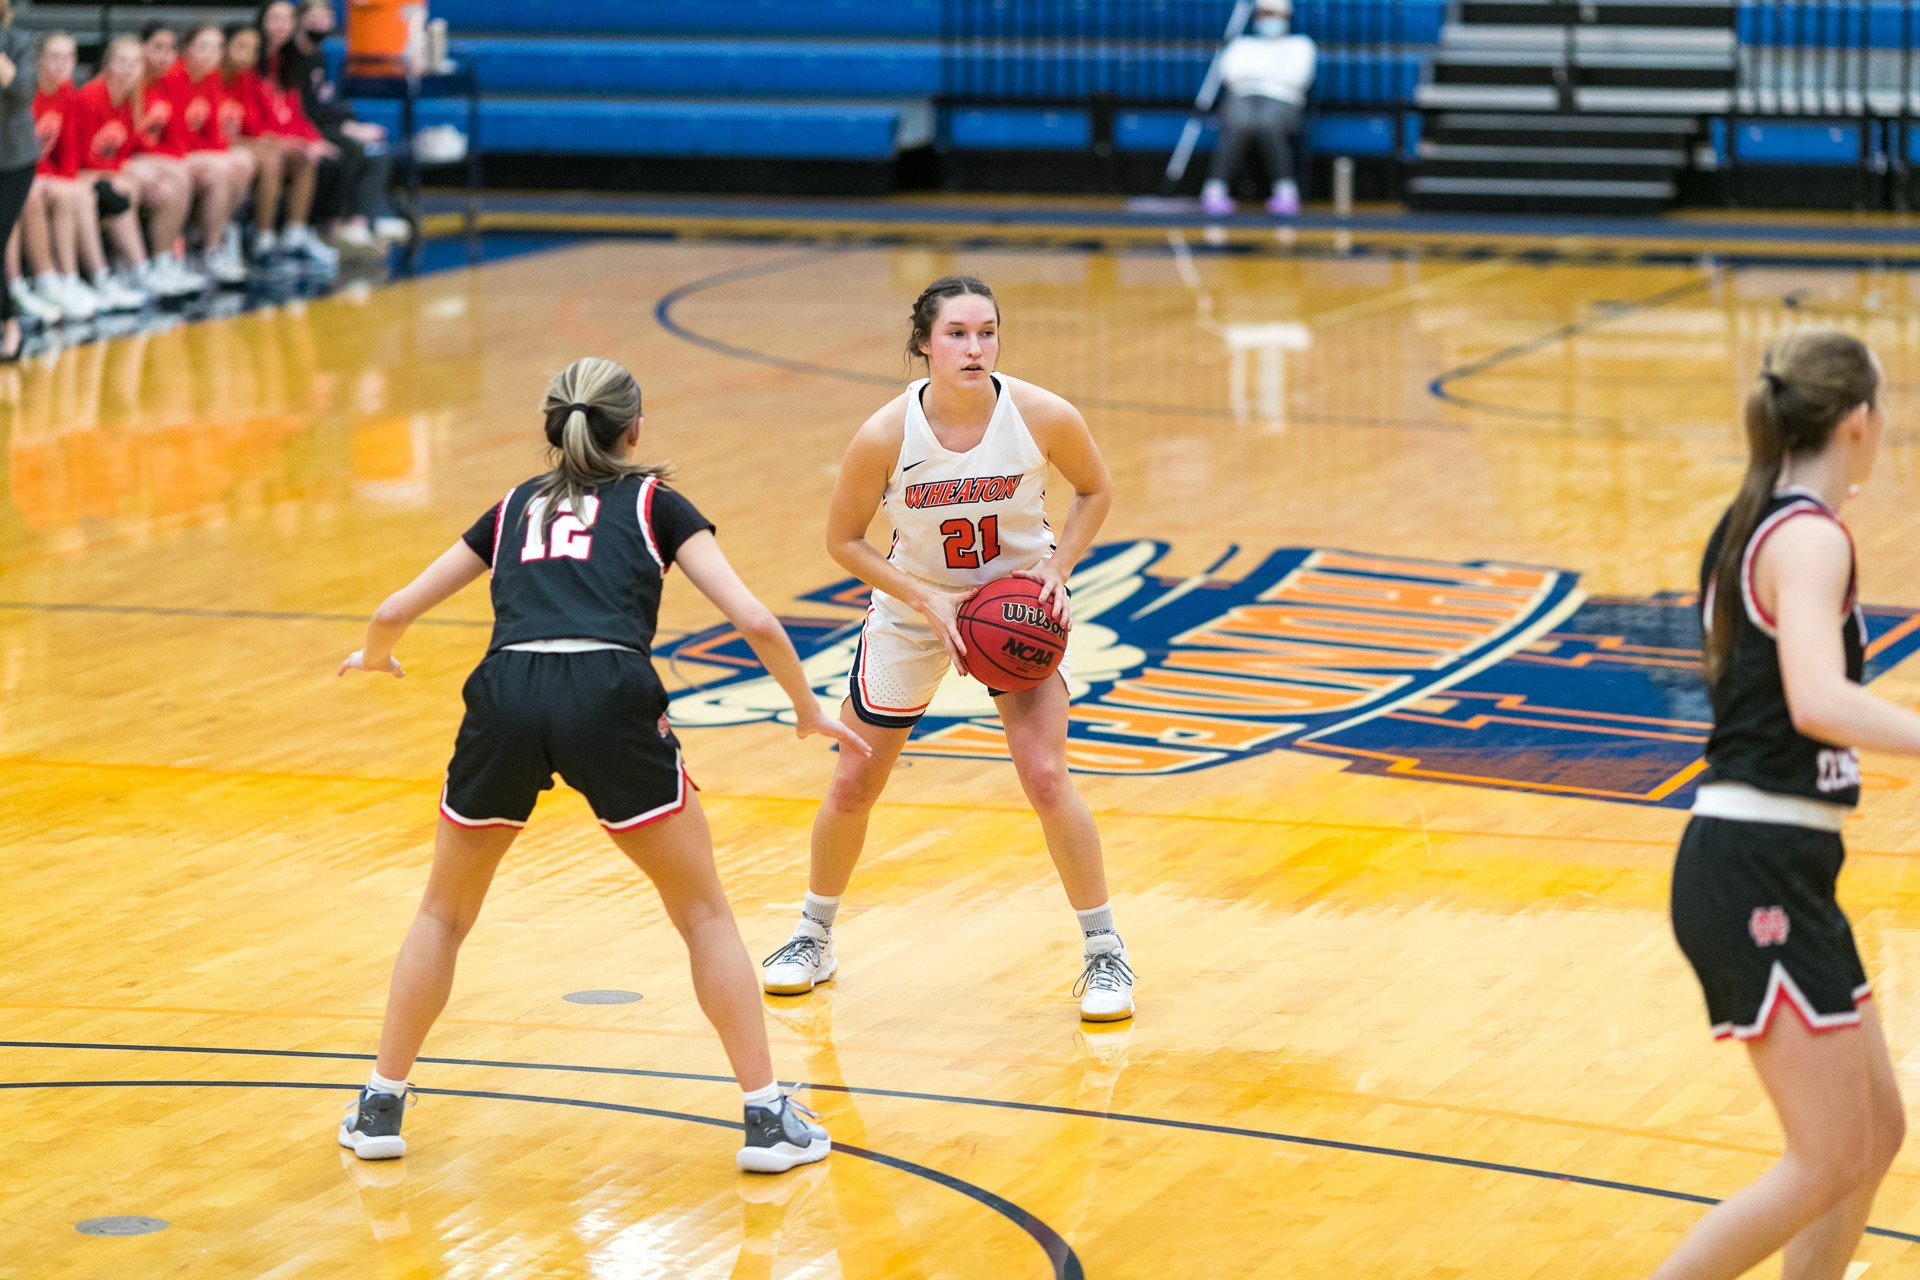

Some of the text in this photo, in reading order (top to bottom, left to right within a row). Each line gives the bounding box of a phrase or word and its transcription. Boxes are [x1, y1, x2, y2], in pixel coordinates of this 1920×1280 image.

[905, 474, 1023, 508] WHEATON
[521, 494, 601, 564] 12
[940, 514, 1000, 569] 21
[1002, 602, 1066, 641] Wilson
[1002, 636, 1054, 667] NCAA
